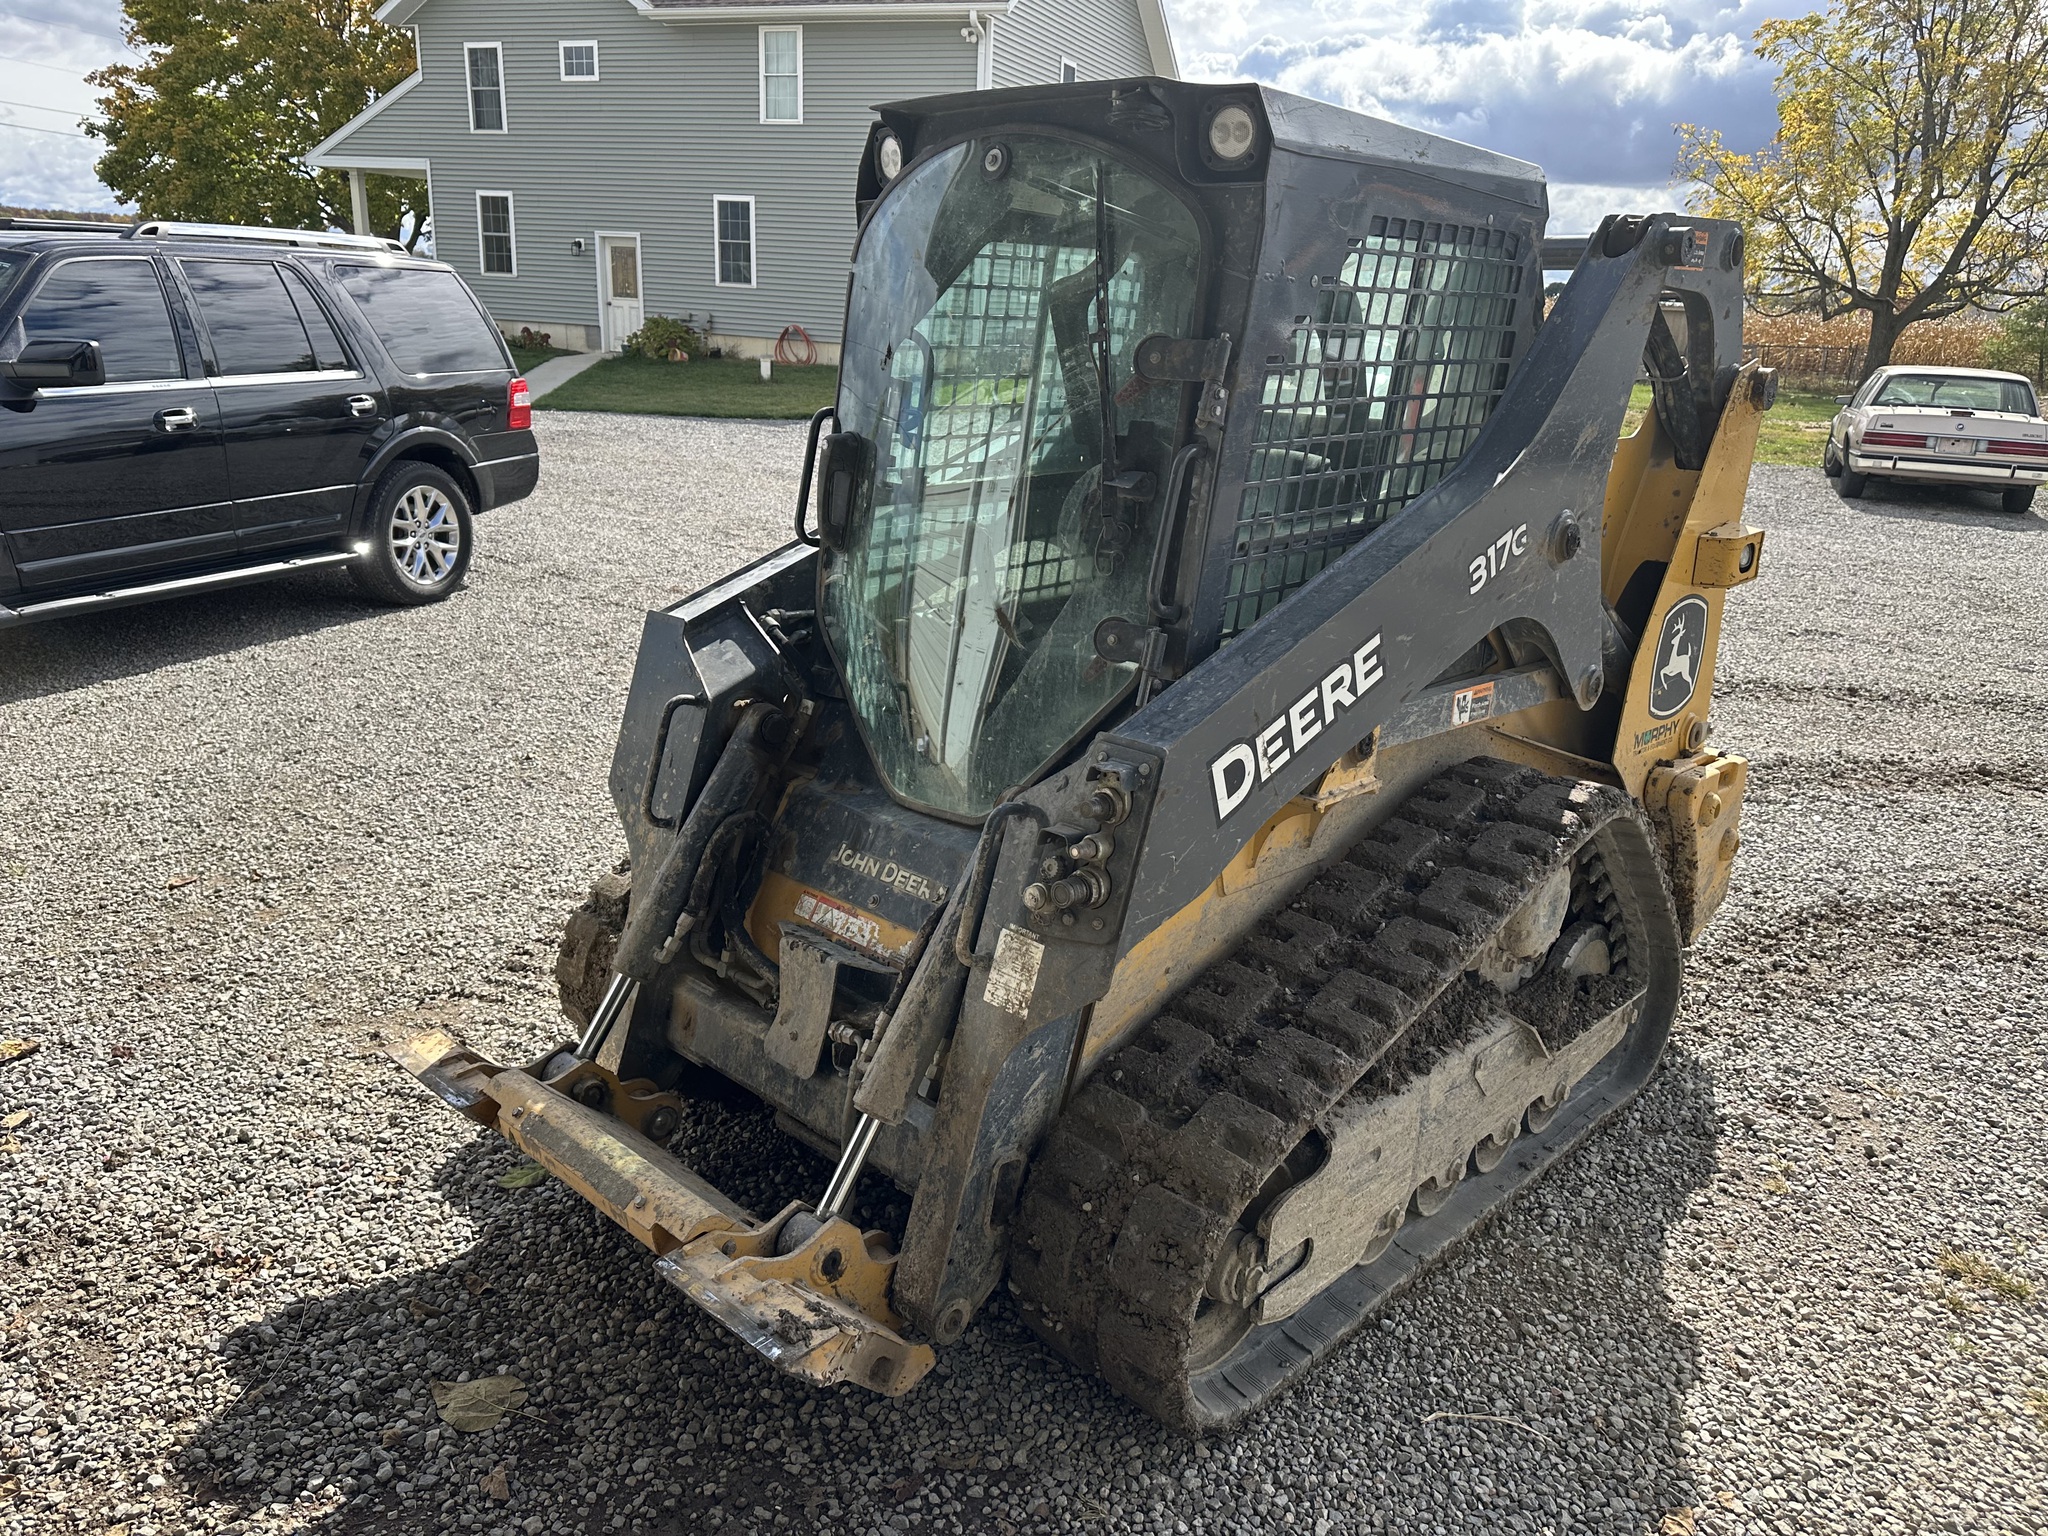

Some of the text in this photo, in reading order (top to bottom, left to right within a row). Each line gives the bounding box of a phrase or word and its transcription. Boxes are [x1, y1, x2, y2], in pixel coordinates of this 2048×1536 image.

[1468, 523, 1528, 595] 317G
[1211, 632, 1385, 820] DEERE
[1633, 718, 1680, 750] MURPHY
[832, 843, 881, 878] JOHN
[1008, 922, 1041, 940] IMORTANT
